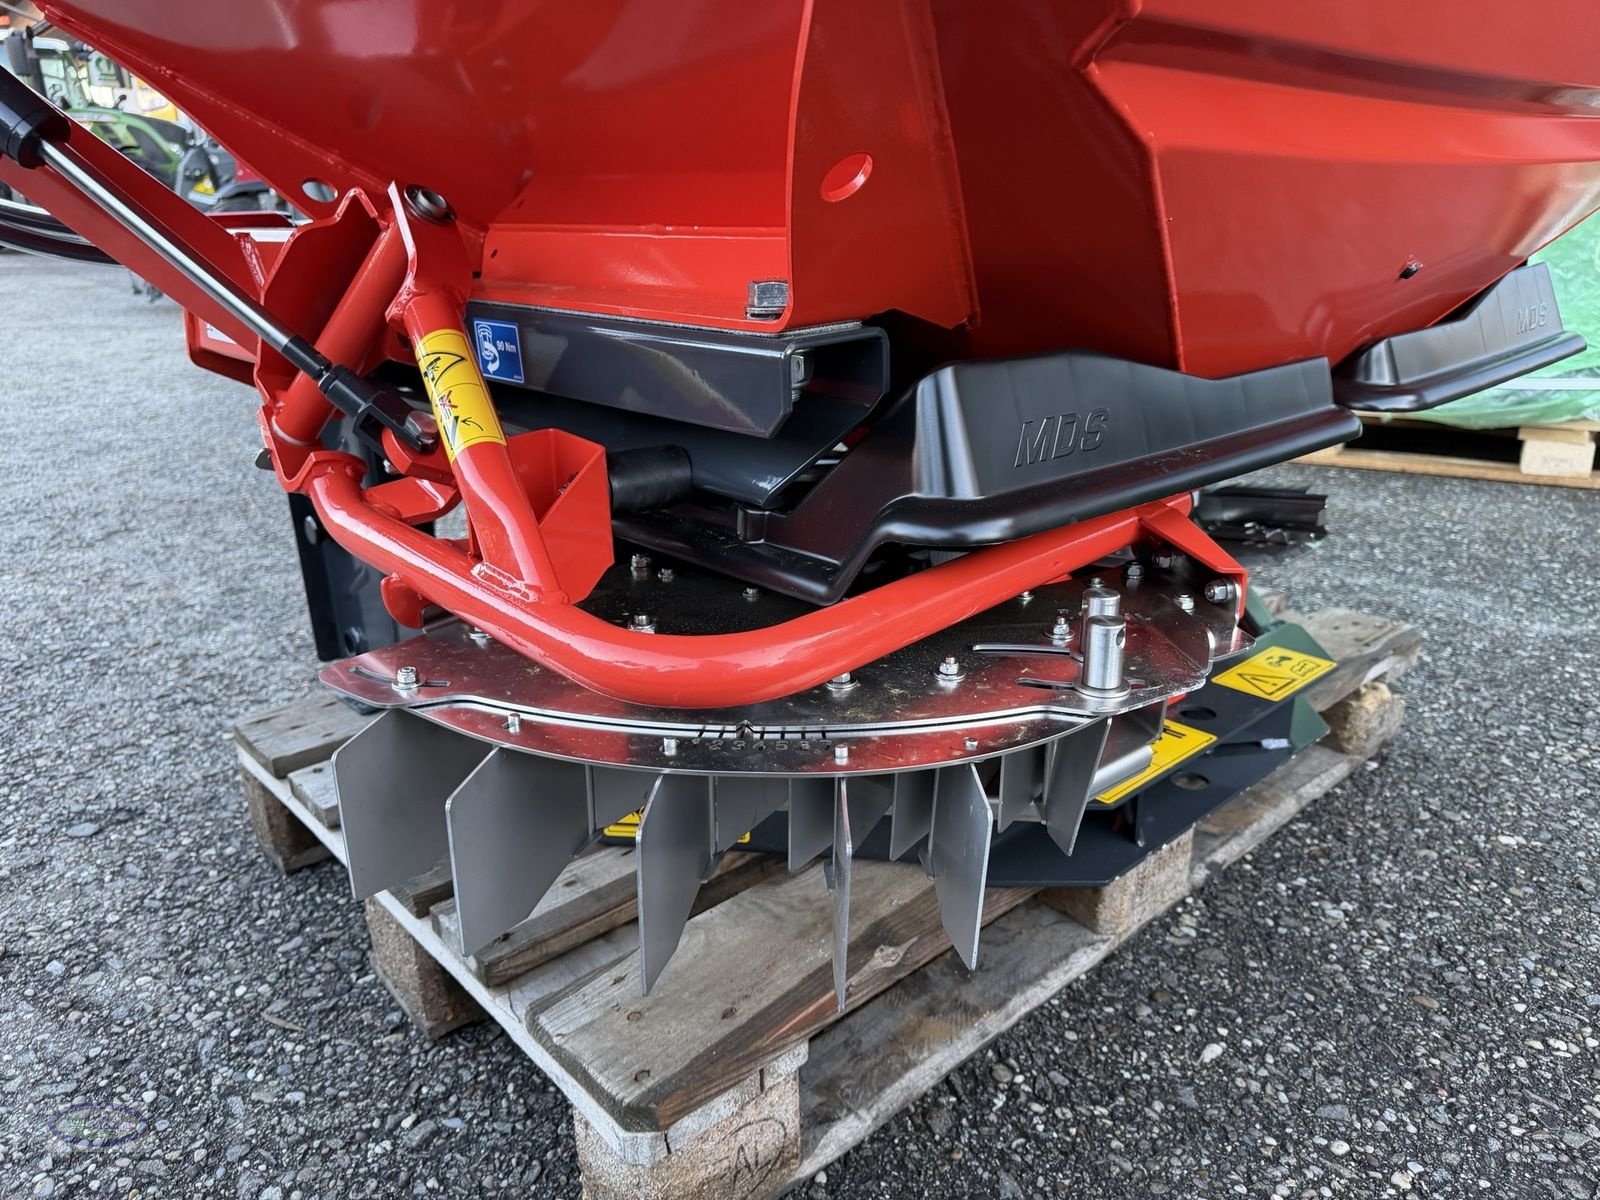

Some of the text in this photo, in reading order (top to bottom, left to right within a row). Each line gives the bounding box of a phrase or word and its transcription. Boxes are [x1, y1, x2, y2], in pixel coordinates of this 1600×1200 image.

[1516, 301, 1547, 335] MDS
[496, 340, 517, 353] 90 Nm
[1013, 406, 1110, 468] MDS
